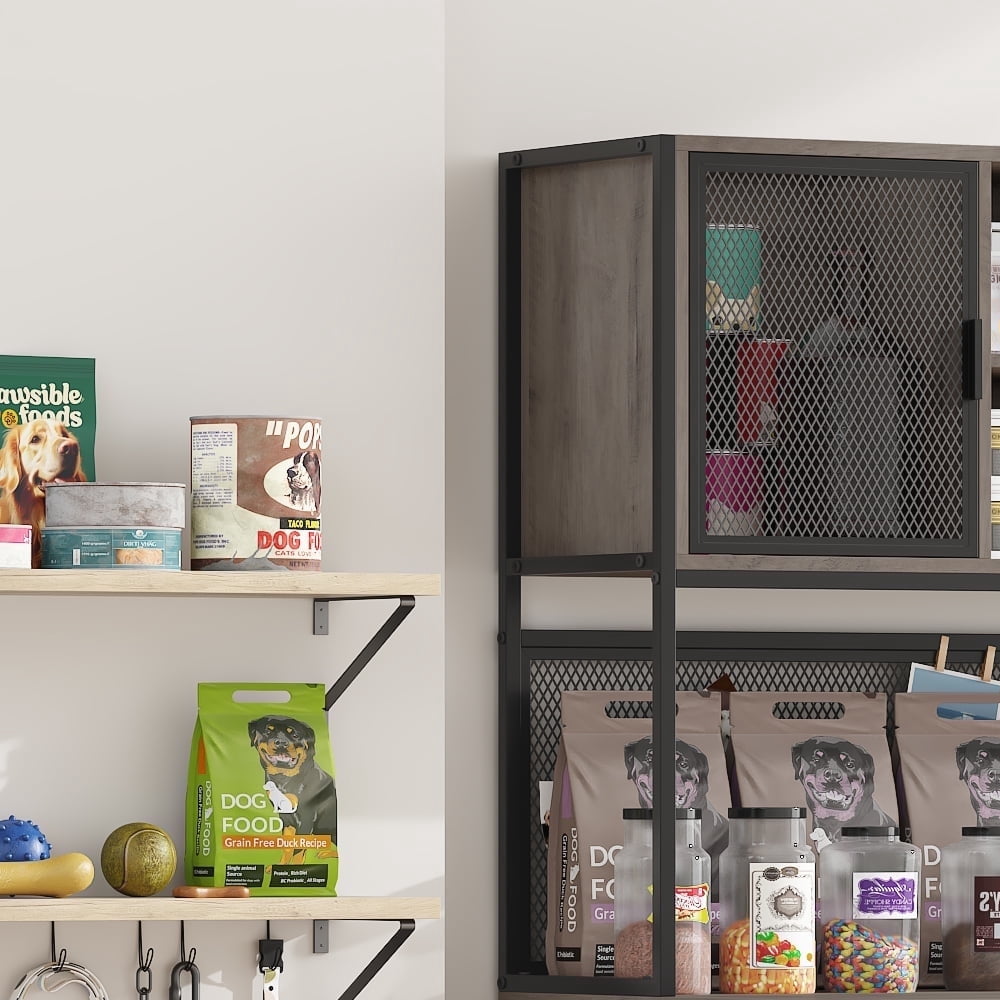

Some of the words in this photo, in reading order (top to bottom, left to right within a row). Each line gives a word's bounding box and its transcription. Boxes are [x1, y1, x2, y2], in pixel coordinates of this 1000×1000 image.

[0, 382, 81, 405] awsible
[19, 403, 83, 428] foods
[288, 519, 304, 529] TACO
[257, 530, 301, 550] DOG
[221, 793, 267, 810] DOG
[222, 817, 284, 833] FOOD
[202, 822, 211, 857] FOOD
[224, 837, 251, 848] Grain
[253, 837, 275, 848] Free
[276, 837, 299, 848] Duck
[300, 837, 327, 850] Recipe
[567, 885, 578, 933] FOOD
